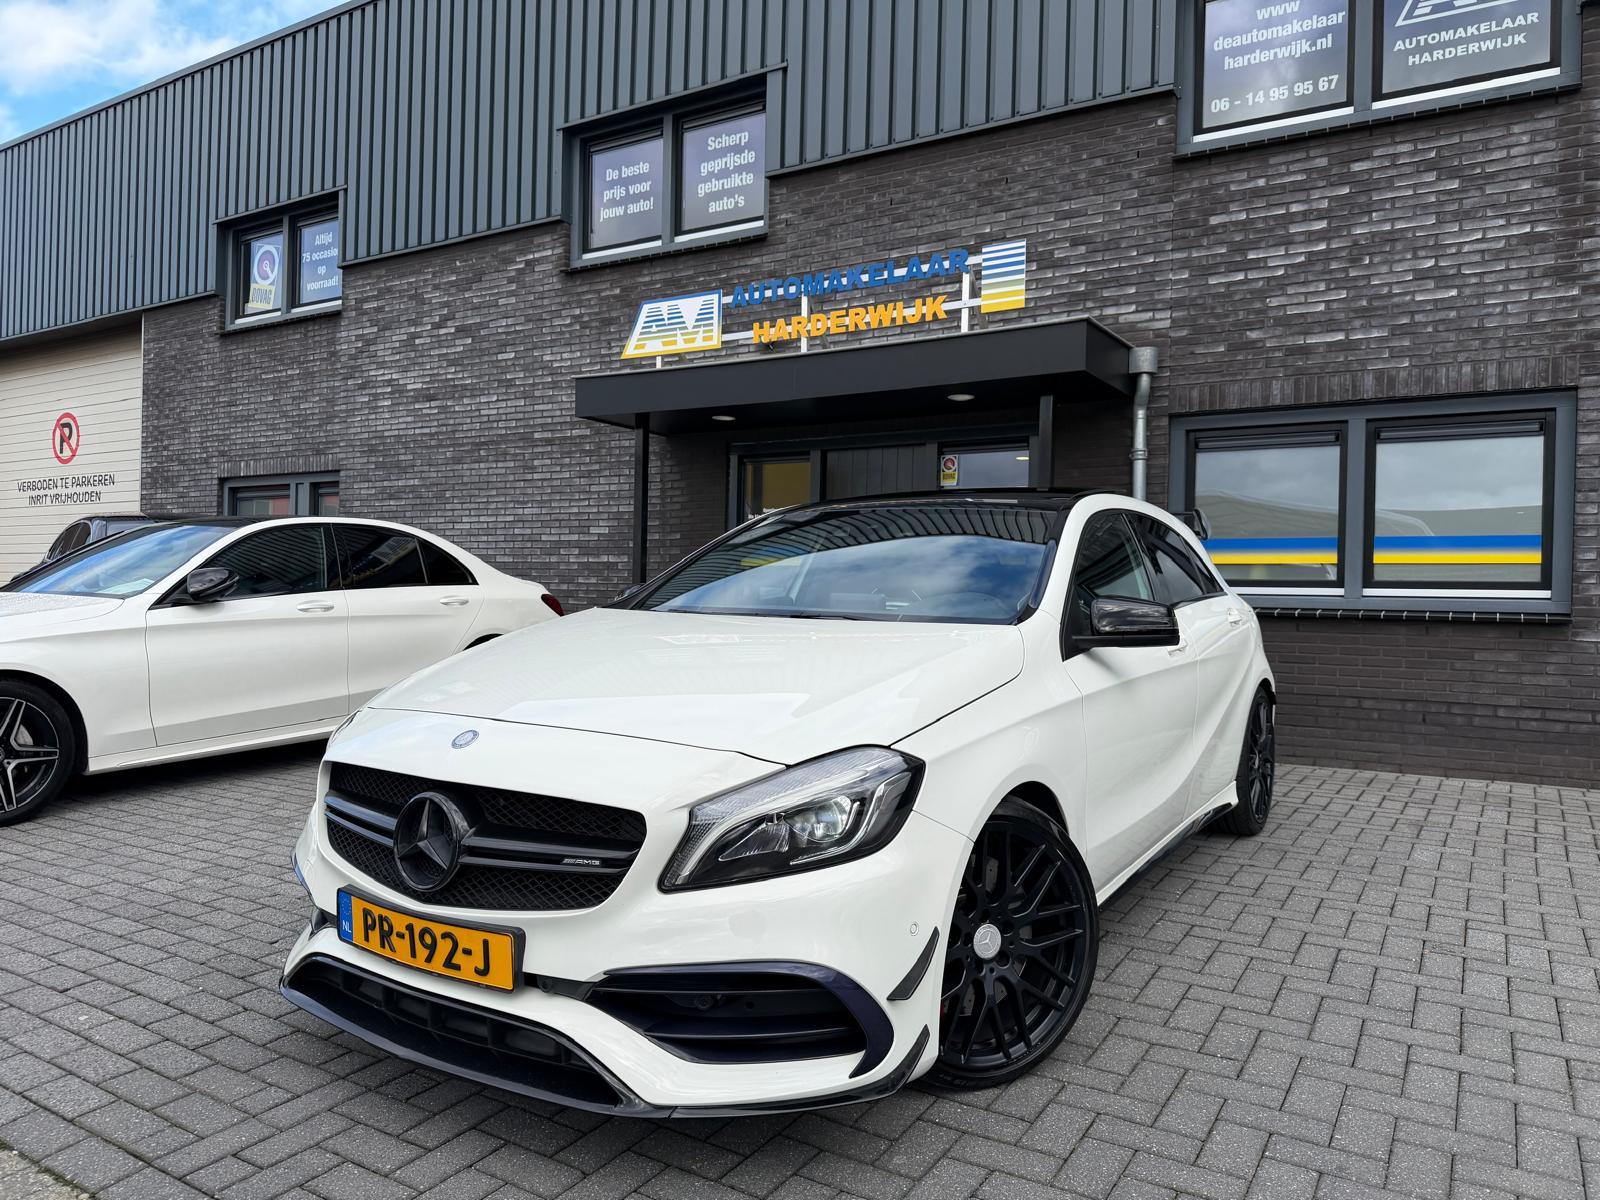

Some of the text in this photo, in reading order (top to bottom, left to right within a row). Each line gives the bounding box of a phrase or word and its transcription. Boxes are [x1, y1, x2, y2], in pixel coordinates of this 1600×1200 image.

[1256, 0, 1301, 20] www
[1213, 11, 1345, 51] deautomakelaar
[1394, 12, 1539, 51] AUTOMAKELAAR
[1224, 33, 1333, 70] harderwijk.nl
[1408, 33, 1527, 66] HARDERWIJK
[1211, 98, 1230, 113] 06
[1245, 90, 1264, 106] 14
[1269, 85, 1288, 101] 95
[1294, 80, 1313, 96] 95
[1318, 74, 1339, 92] 67
[707, 131, 749, 150] Scherp
[606, 161, 650, 181] De beste
[700, 149, 756, 176] geprijsde
[603, 180, 652, 203] prijs voor
[697, 171, 754, 197] gebruikte
[600, 196, 654, 222] jouw auto!
[708, 194, 745, 213] auto's
[314, 231, 333, 246] Altijd
[302, 246, 338, 263] 75 occasio
[317, 265, 327, 276] op
[730, 248, 970, 308] AUTOMAKELAAR
[306, 275, 339, 291] voorraad!
[753, 294, 948, 343] HARDERWIJK
[17, 474, 115, 492] VERBODEN TE PARKEREN
[28, 491, 102, 506] INRIT VRIJHOUDEN
[342, 920, 352, 933] NL
[362, 907, 490, 977] PR-192-J
